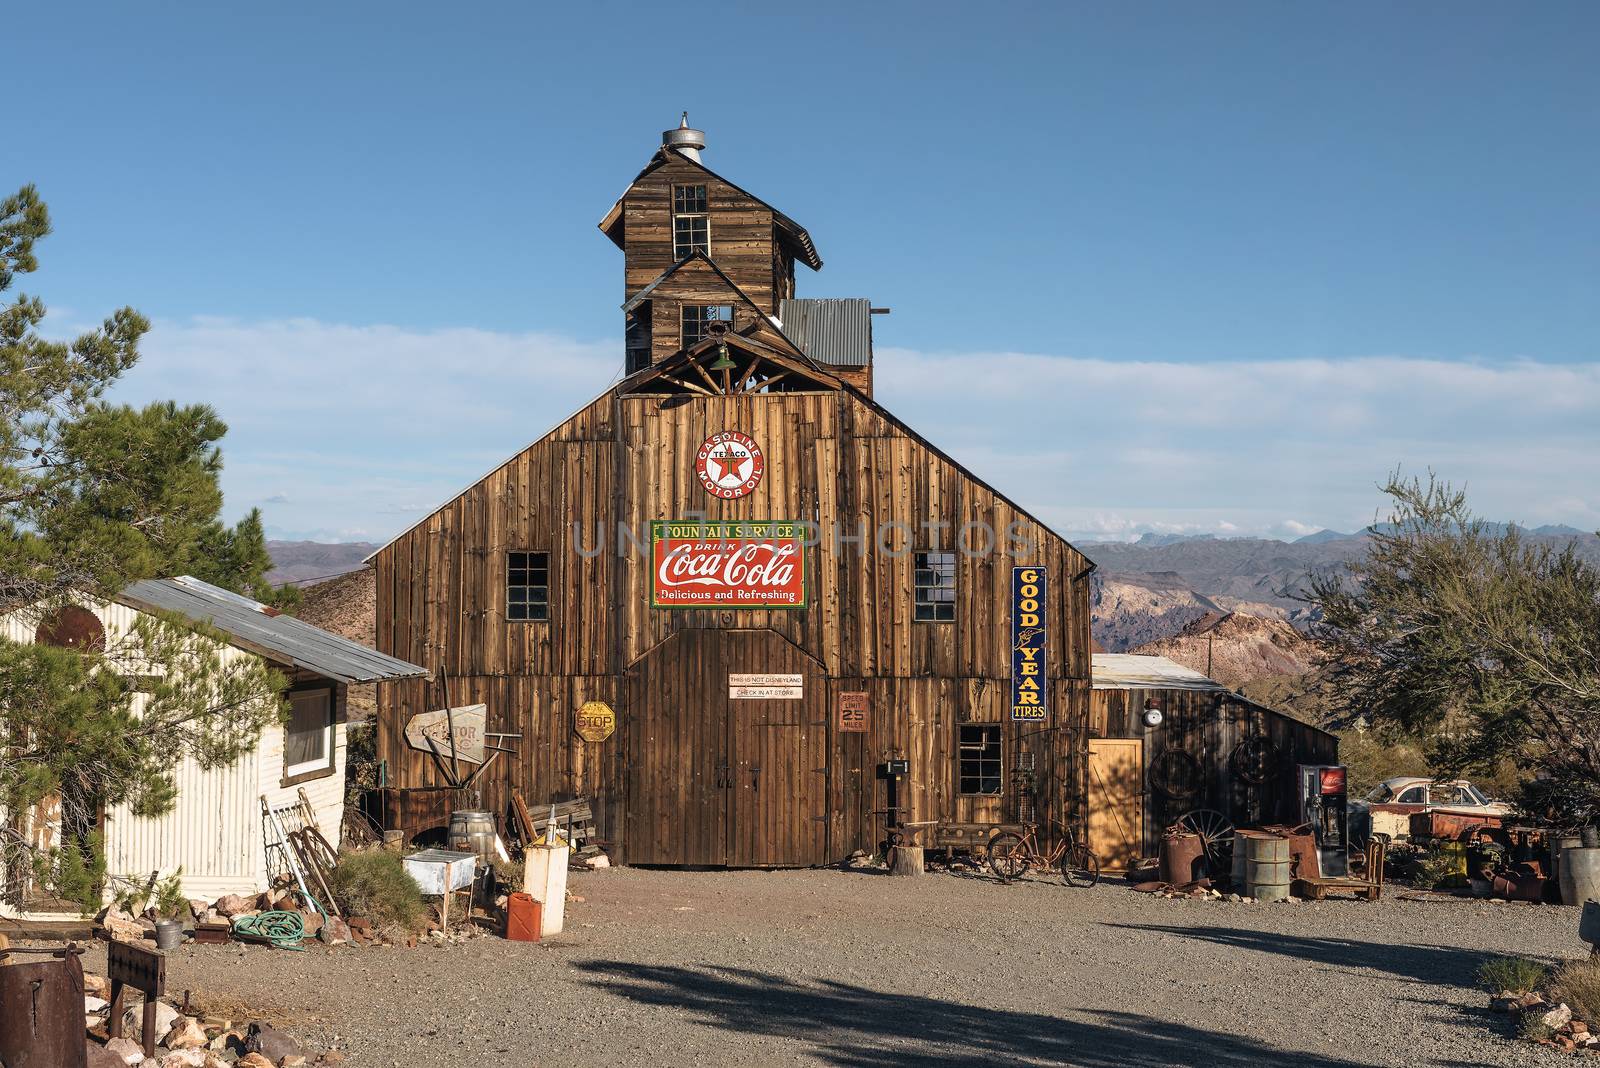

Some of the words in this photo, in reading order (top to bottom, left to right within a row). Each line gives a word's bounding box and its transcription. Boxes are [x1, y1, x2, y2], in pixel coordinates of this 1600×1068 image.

[699, 432, 761, 460] GASOLINE
[698, 470, 742, 498] MOTOR
[746, 468, 762, 489] OIL
[664, 526, 730, 538] FOUNTAIN
[735, 526, 793, 538] SERVICE
[694, 543, 736, 551] DRINK
[661, 589, 711, 600] Delicious
[714, 589, 733, 600] and
[737, 589, 795, 602] Refreshing
[1020, 569, 1040, 627] GOOD
[1019, 647, 1041, 705] YEAR
[842, 709, 864, 721] 25
[1013, 706, 1045, 717] TIRES
[577, 716, 612, 728] STOP
